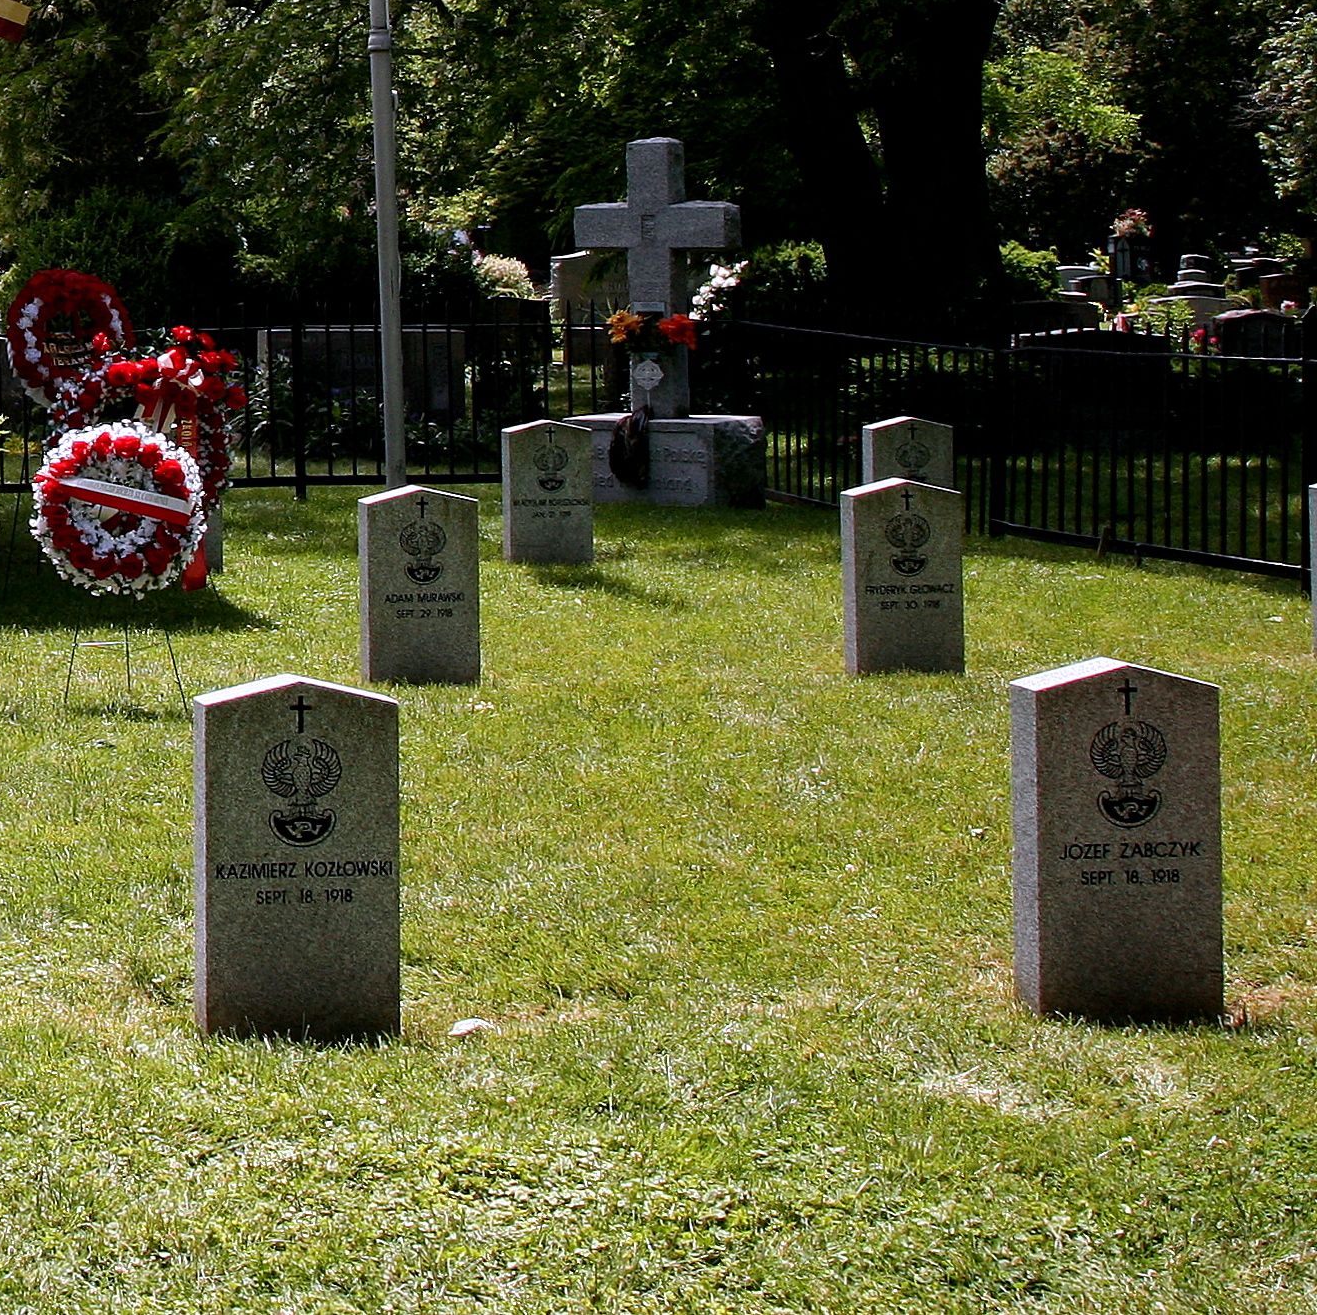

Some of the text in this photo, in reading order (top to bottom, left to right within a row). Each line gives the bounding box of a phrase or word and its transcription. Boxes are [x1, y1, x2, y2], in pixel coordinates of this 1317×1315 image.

[384, 593, 414, 604] ADAM
[437, 607, 454, 618] 1918
[215, 860, 394, 880] KAZIMIERZ KOZŁOWSKI
[1080, 870, 1116, 886] SEPT.
[1151, 868, 1180, 884] 1918
[256, 890, 291, 905] SEPT.
[324, 888, 353, 904] 1918
